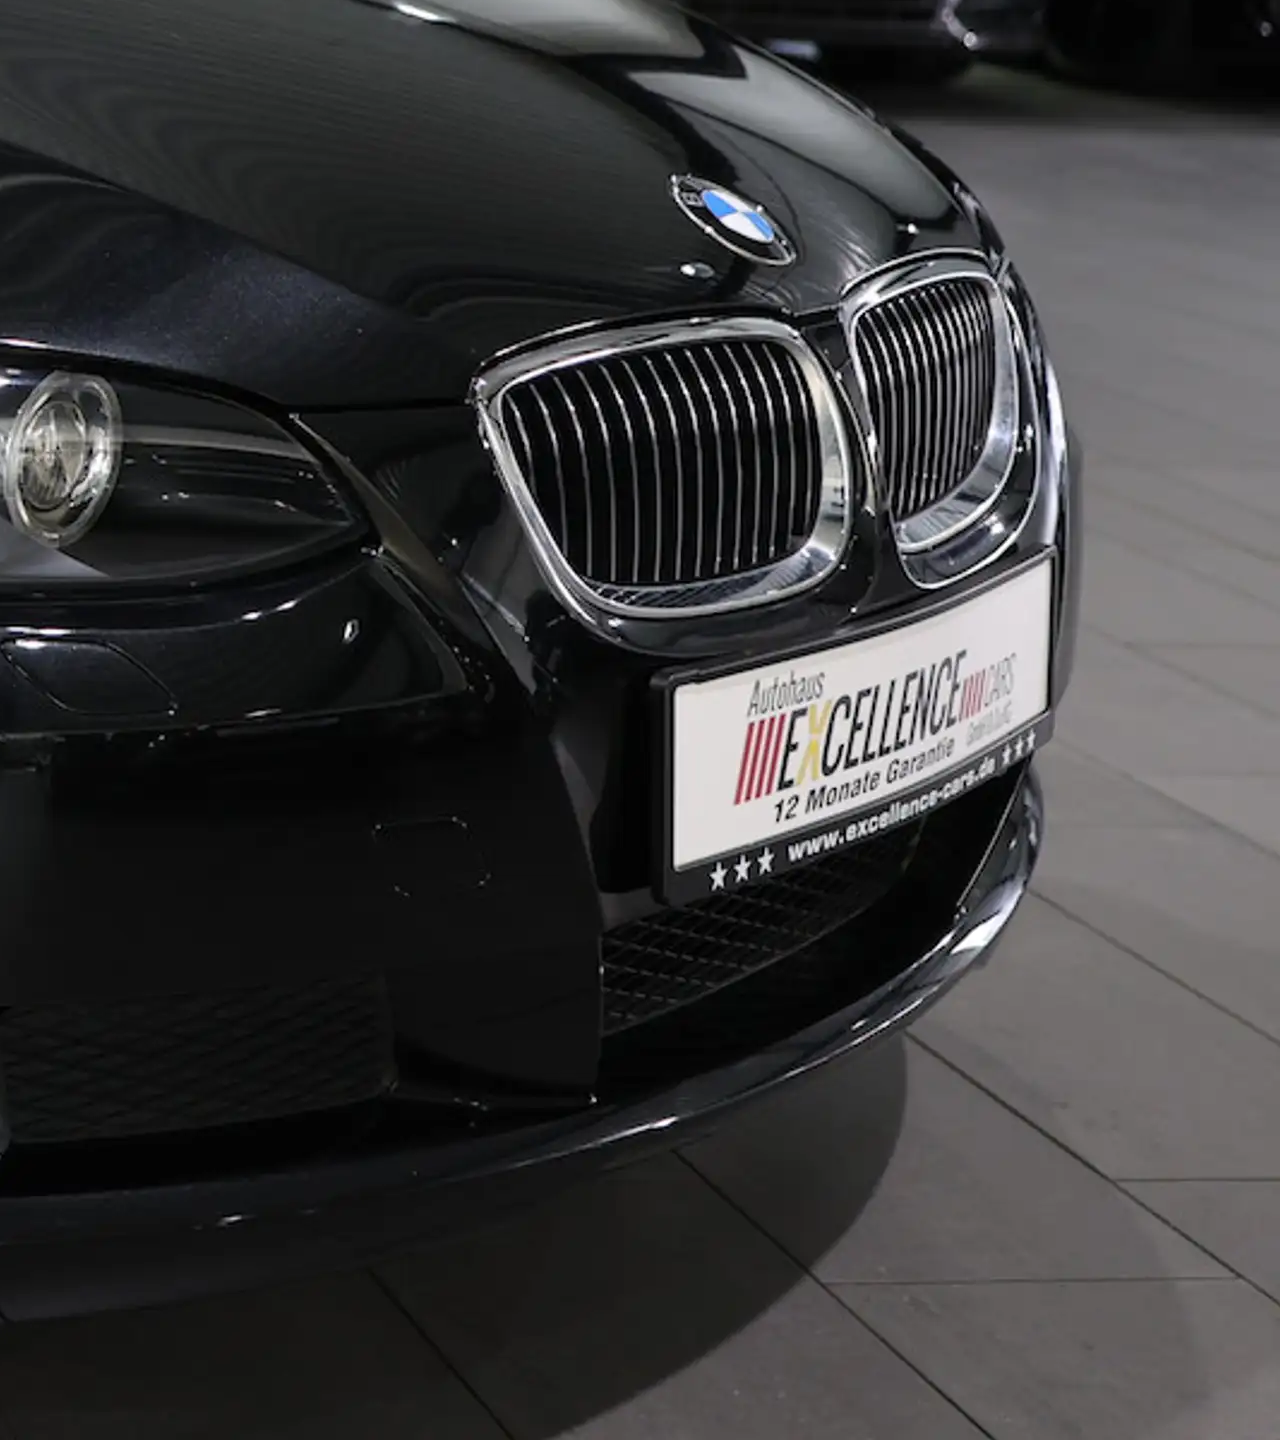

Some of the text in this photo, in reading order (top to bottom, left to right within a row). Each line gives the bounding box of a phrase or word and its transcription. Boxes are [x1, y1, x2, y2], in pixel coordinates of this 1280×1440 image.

[746, 670, 827, 717] Autohaus
[775, 649, 968, 792] EXCELLENCE
[774, 735, 956, 824] 12 Monate Garantie
[787, 756, 997, 862] www.excellence-cars.de
